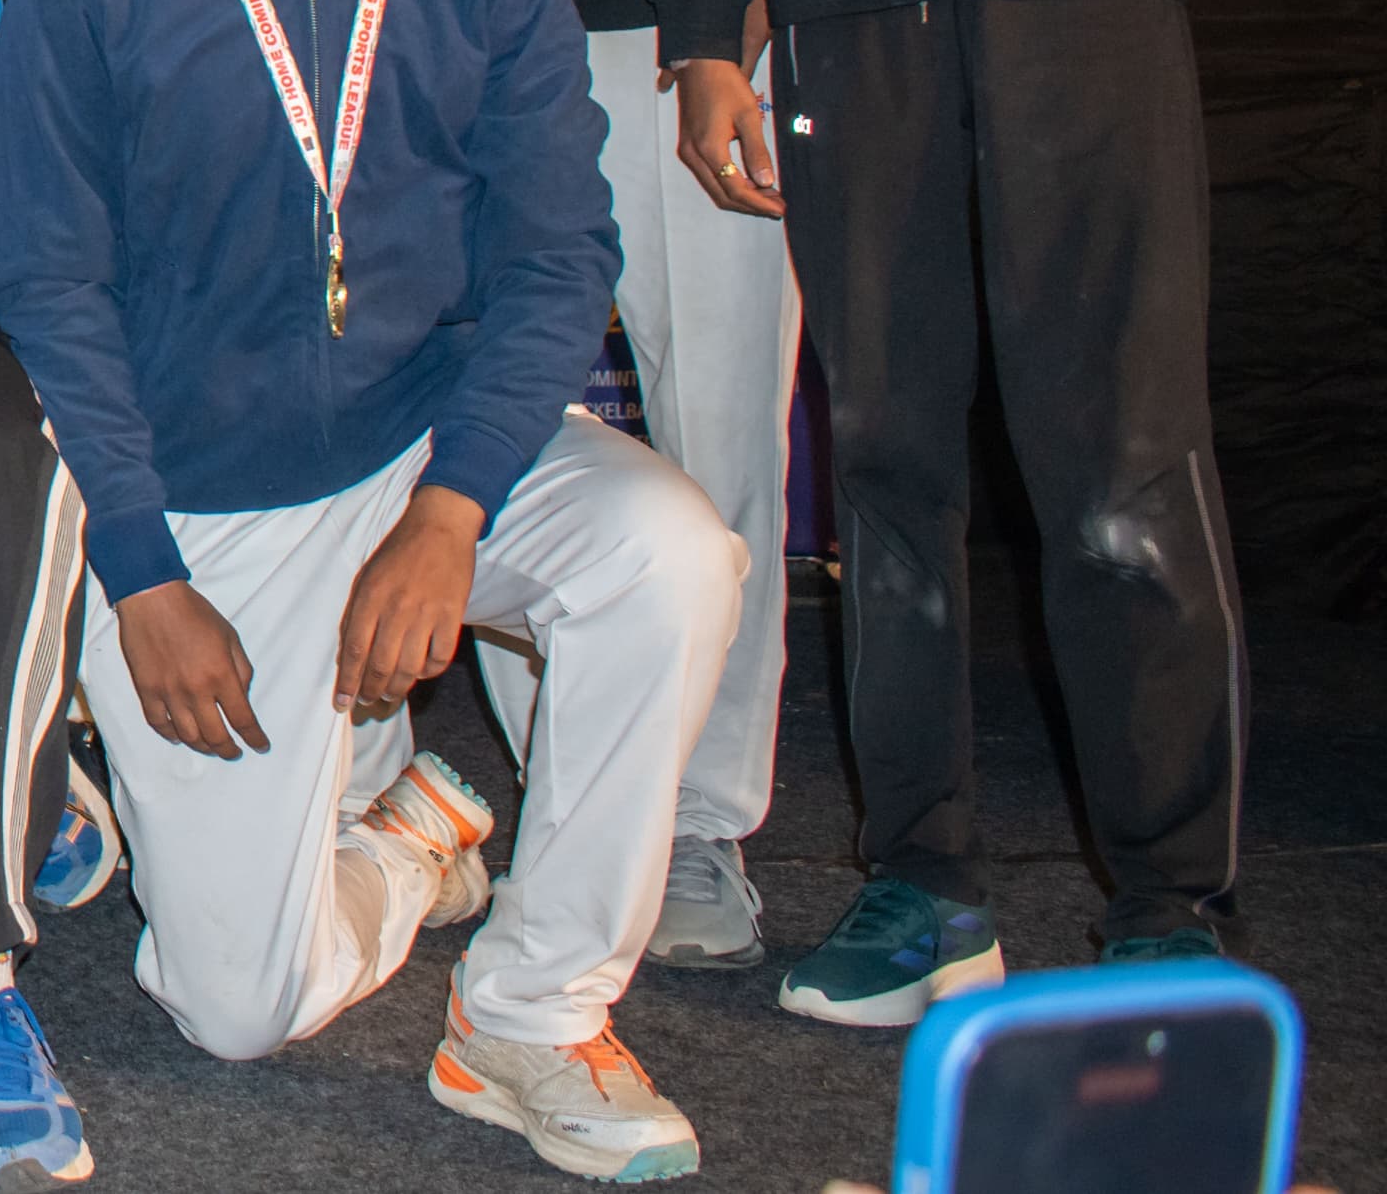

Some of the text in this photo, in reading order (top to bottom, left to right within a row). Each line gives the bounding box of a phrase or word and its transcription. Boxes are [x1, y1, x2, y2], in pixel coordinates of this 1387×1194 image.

[350, 8, 374, 76] SPORTS
[269, 48, 299, 101] HOME
[289, 103, 308, 128] JU
[337, 79, 361, 151] LEAGUE
